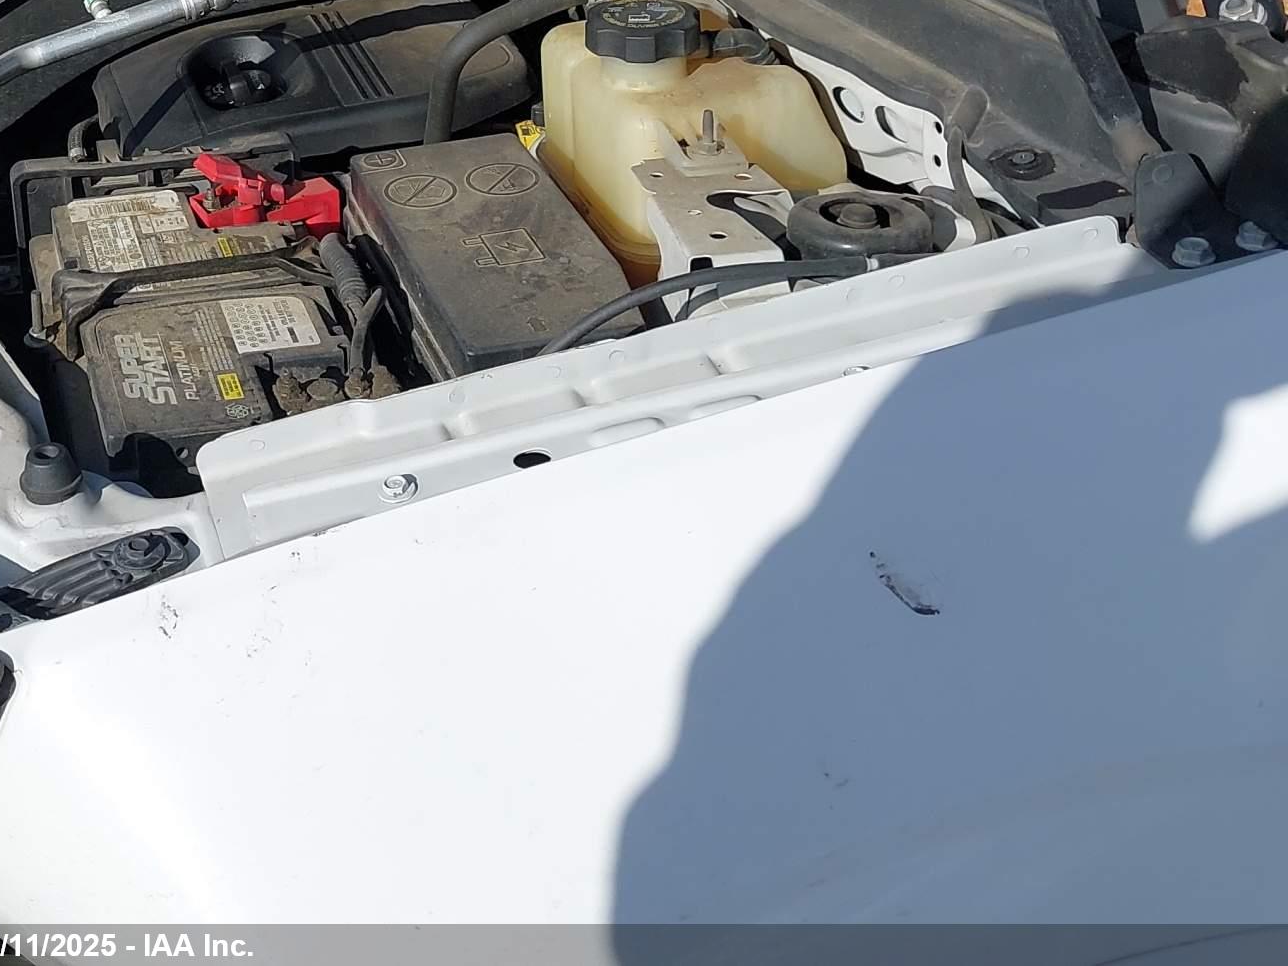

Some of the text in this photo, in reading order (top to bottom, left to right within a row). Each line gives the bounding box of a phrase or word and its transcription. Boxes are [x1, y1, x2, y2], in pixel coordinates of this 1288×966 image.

[114, 334, 144, 400] SUPER
[135, 332, 178, 405] START
[168, 339, 200, 401] PLATINUM
